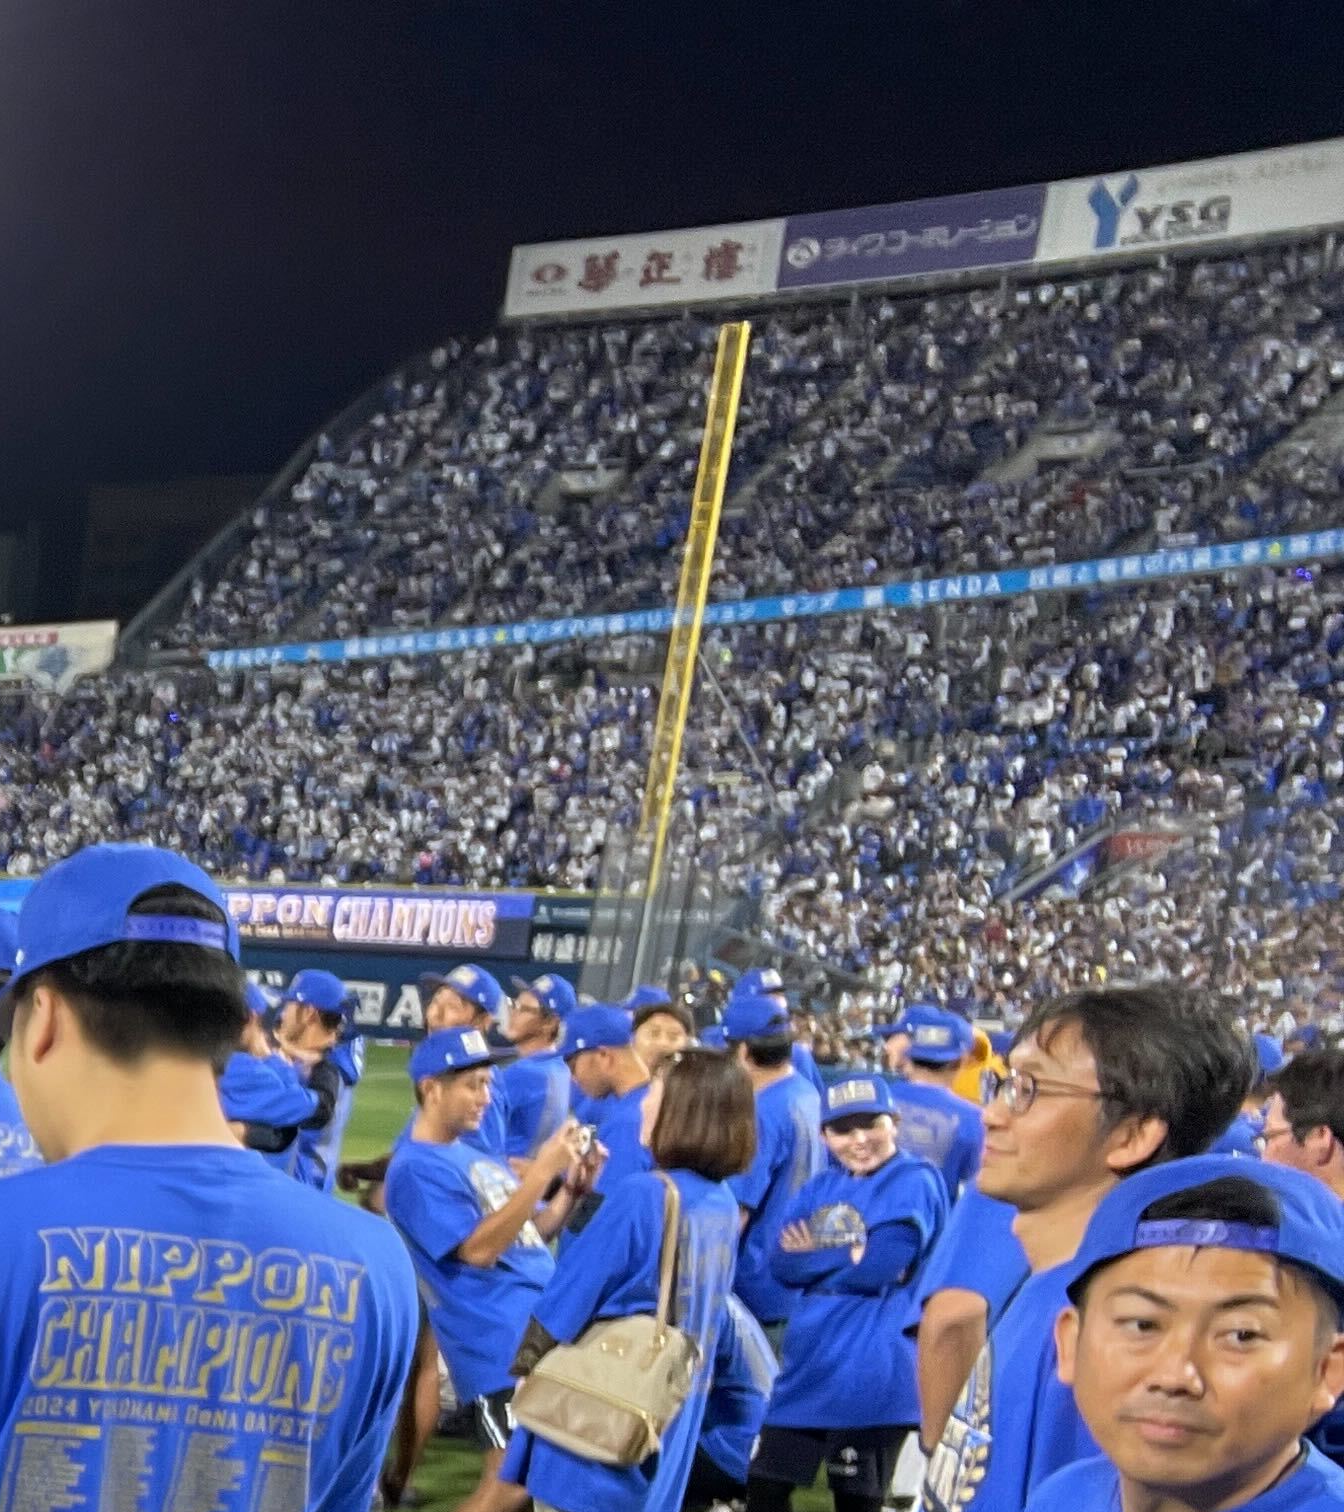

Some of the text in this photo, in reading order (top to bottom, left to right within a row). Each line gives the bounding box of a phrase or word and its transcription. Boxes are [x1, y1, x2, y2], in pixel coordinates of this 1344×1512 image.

[223, 893, 334, 929] PPON
[332, 896, 497, 949] CHAMPIONS
[37, 1226, 365, 1325] NIPPON
[29, 1297, 357, 1414] CHAMPIONS
